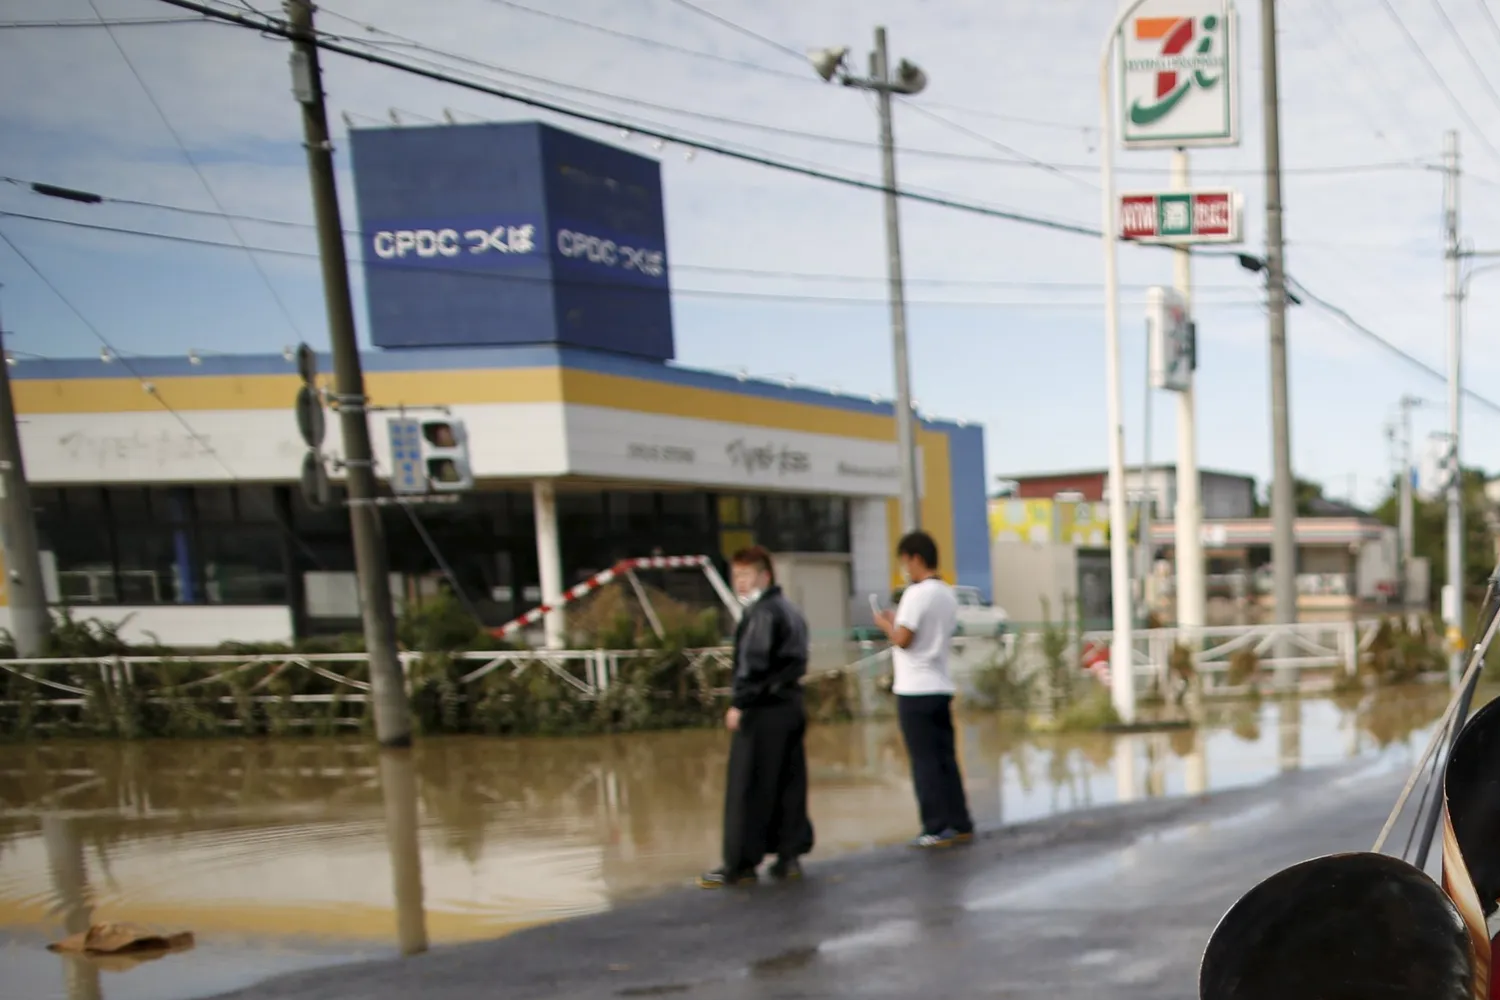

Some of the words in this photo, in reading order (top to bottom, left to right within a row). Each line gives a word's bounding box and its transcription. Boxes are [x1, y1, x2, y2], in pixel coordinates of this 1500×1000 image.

[373, 229, 460, 259] CPDC
[463, 223, 536, 254] つくば
[556, 228, 619, 266] CPDC
